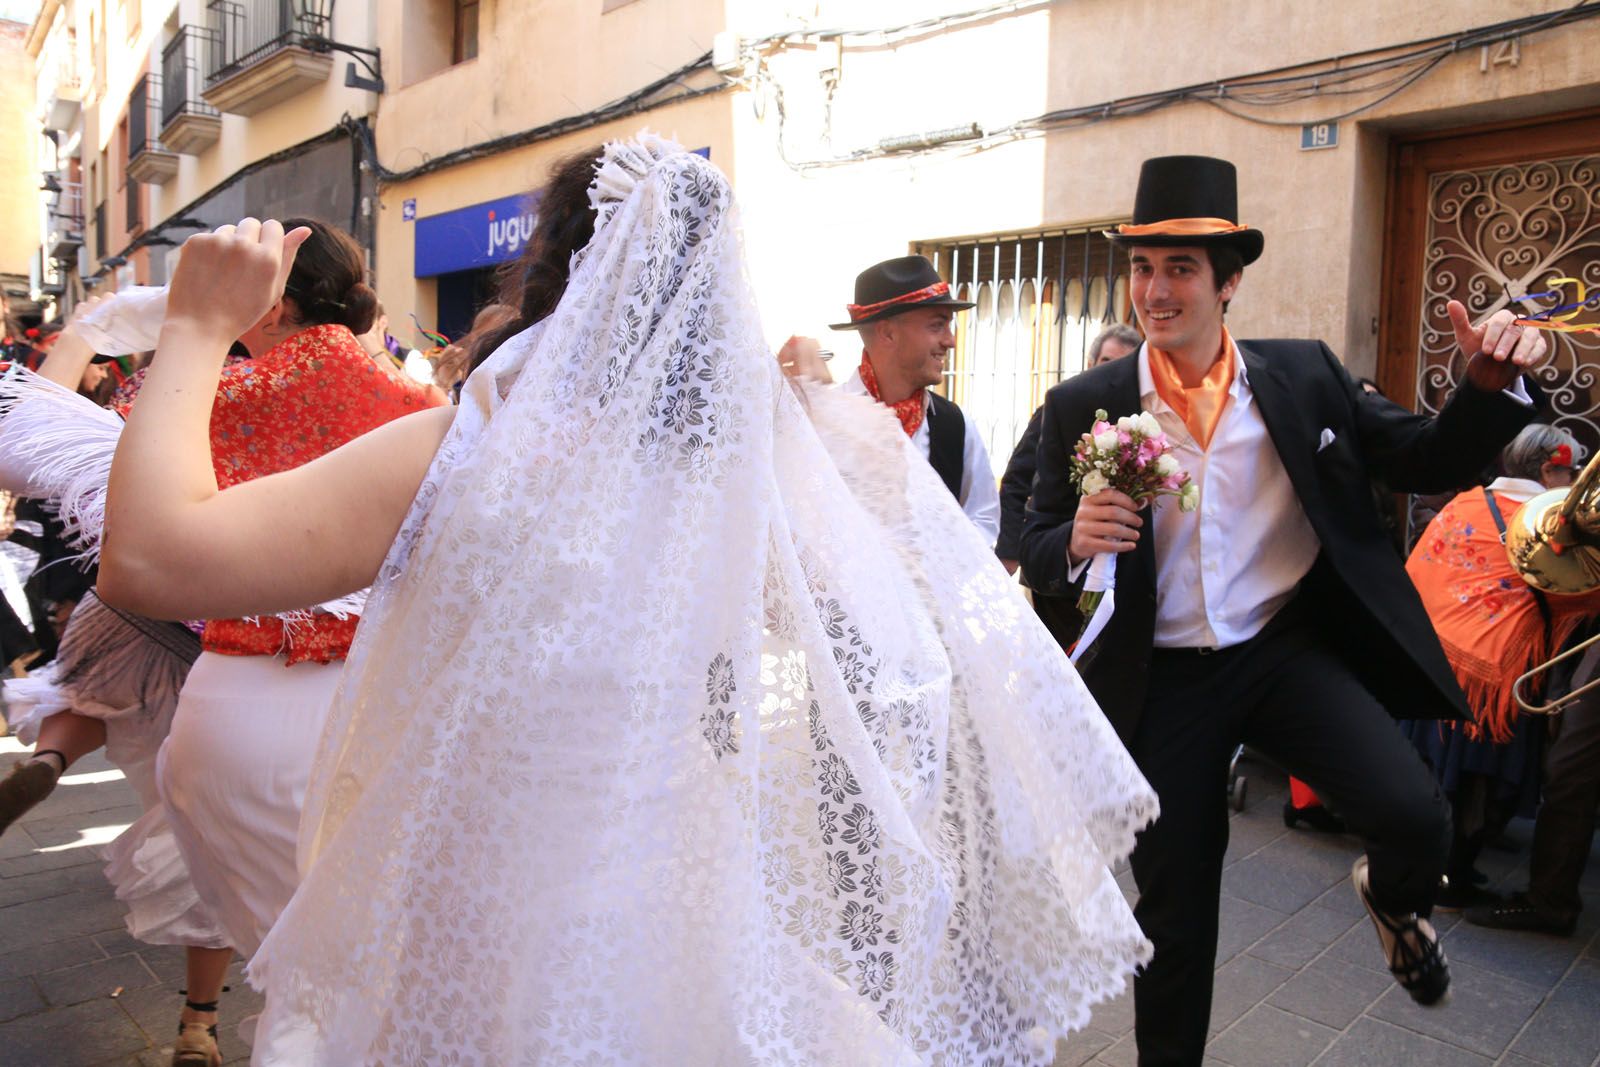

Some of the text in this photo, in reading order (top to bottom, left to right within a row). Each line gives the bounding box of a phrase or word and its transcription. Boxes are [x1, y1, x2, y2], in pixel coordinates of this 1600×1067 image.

[1479, 29, 1520, 74] 14
[1311, 124, 1329, 146] 19
[487, 210, 539, 257] jugu
